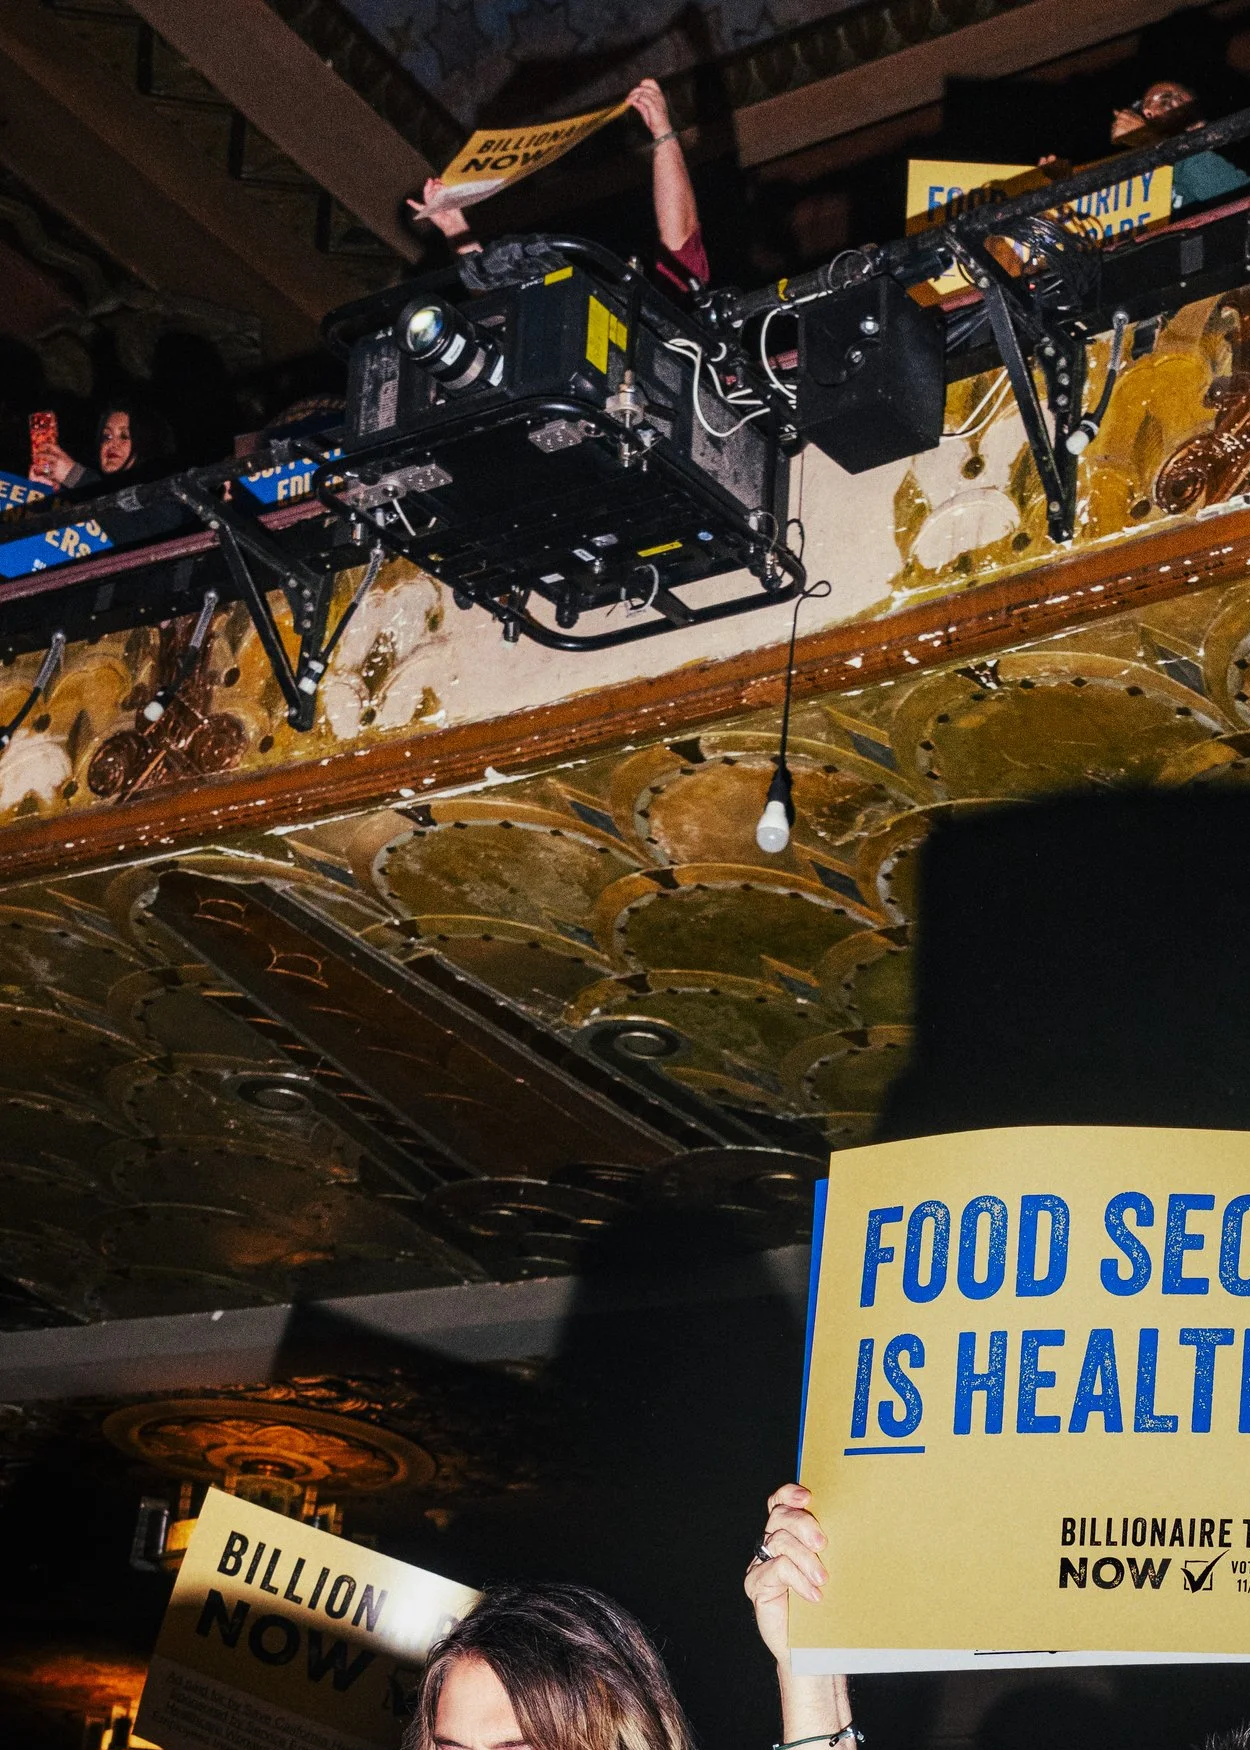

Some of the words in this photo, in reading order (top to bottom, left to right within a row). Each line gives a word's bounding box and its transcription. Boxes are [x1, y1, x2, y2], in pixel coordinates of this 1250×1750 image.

[860, 1193, 1070, 1308] FOOD
[850, 1332, 926, 1440] IS
[1058, 1556, 1173, 1590] NOW
[1061, 1516, 1233, 1548] BILLIONAIRE
[197, 1588, 377, 1692] NOW
